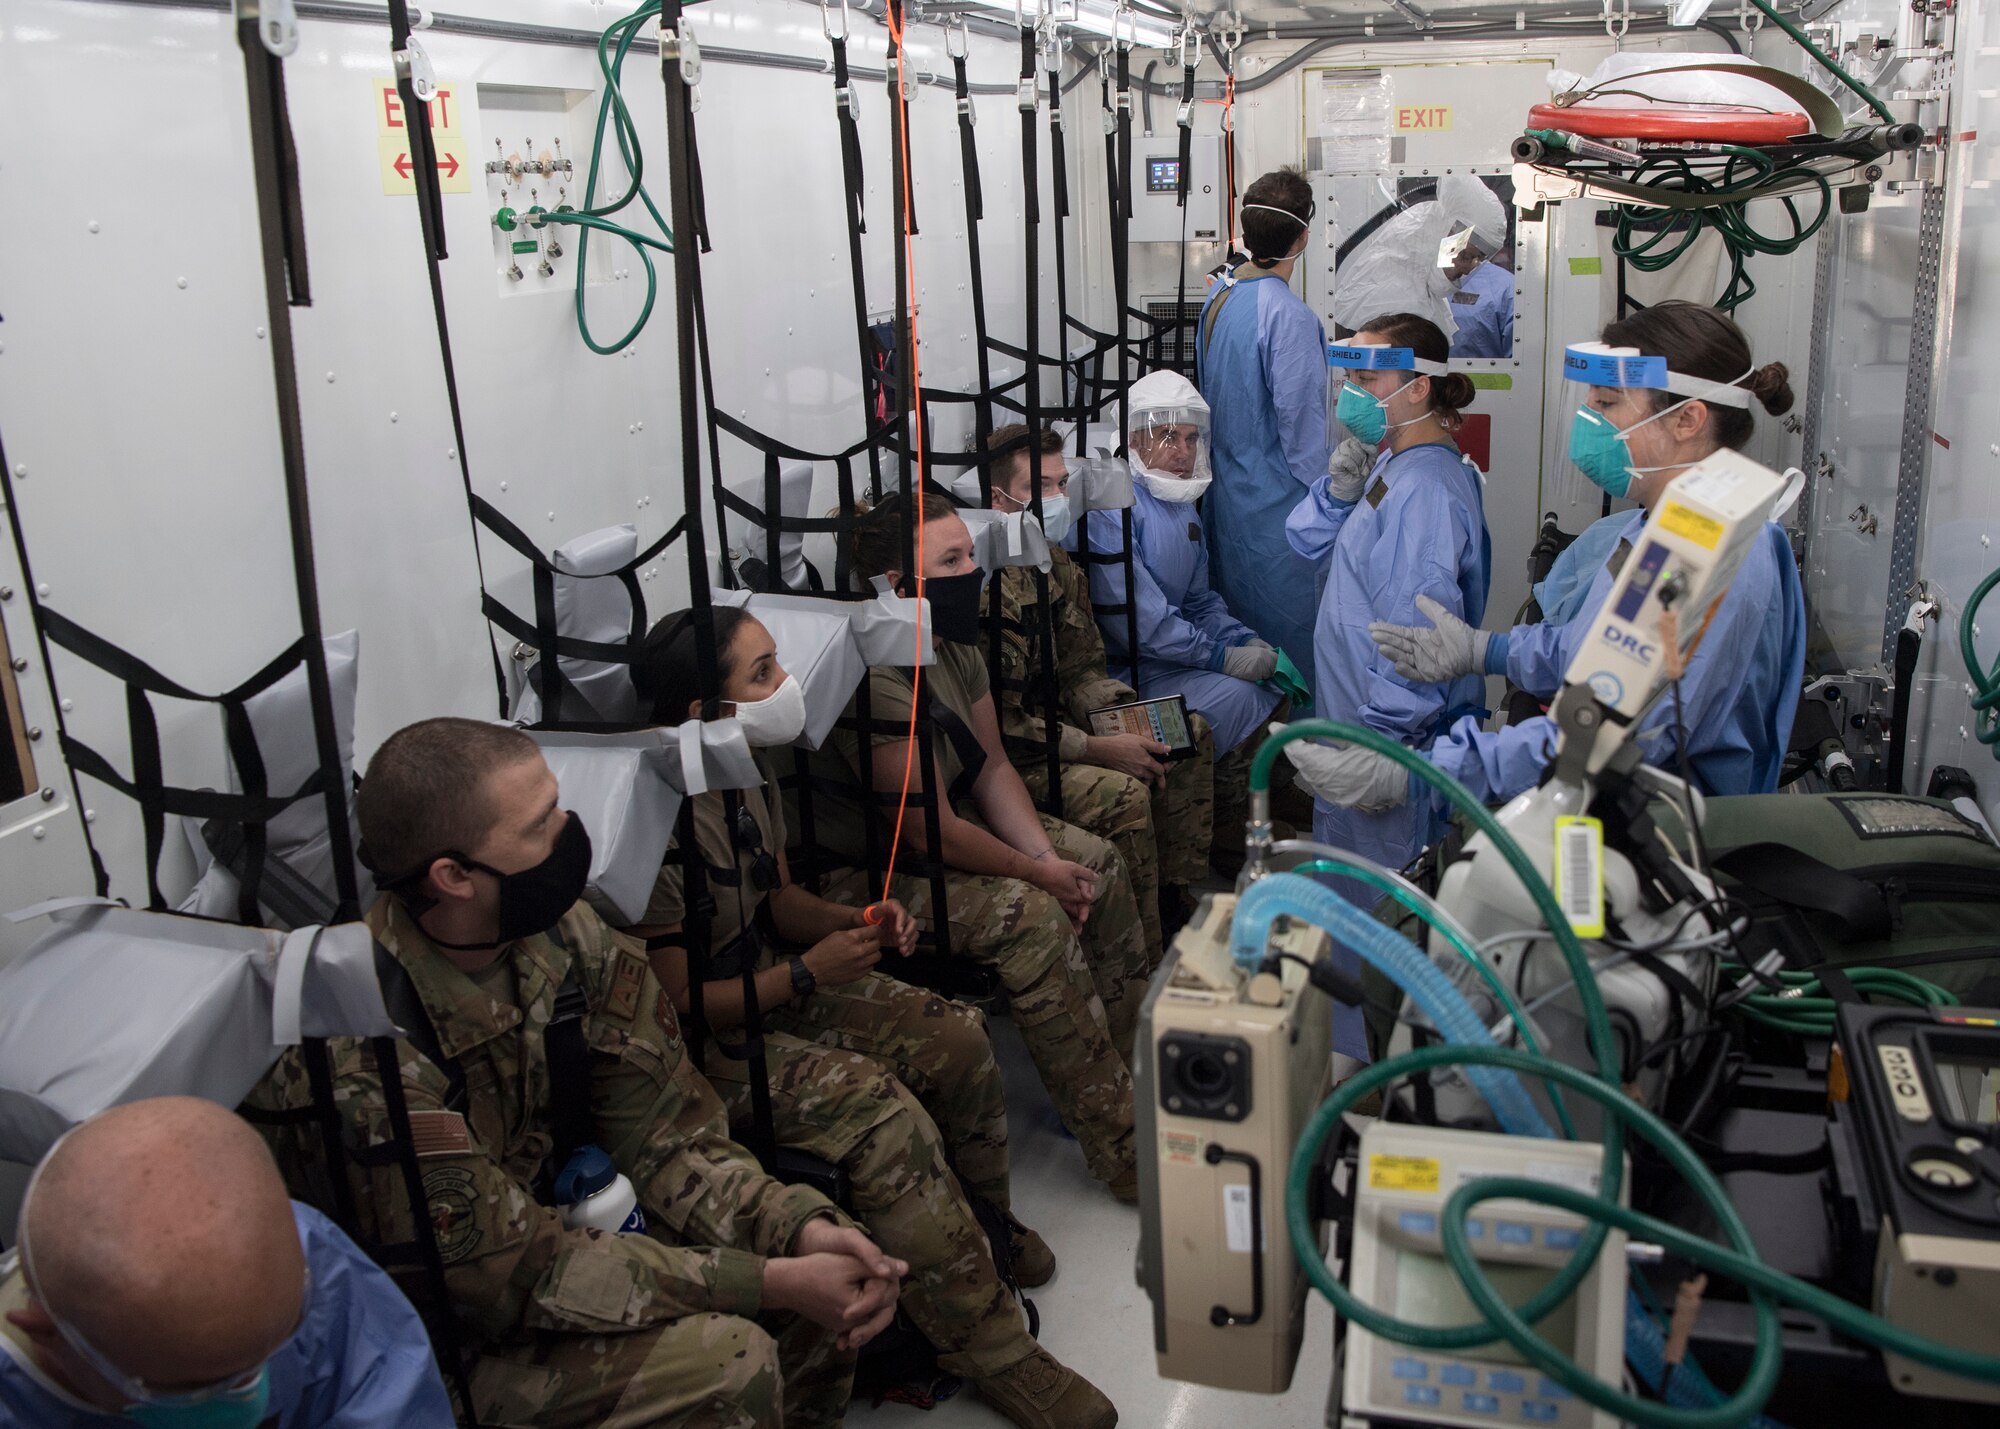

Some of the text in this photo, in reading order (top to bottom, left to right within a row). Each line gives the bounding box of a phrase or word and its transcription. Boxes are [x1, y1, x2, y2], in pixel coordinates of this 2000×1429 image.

[383, 88, 450, 128] EIT
[1399, 108, 1448, 128] EXIT
[1332, 349, 1362, 360] SHIELD
[1603, 624, 1656, 663] DRC
[613, 956, 643, 1014] AE
[1885, 1049, 1917, 1098] 330
